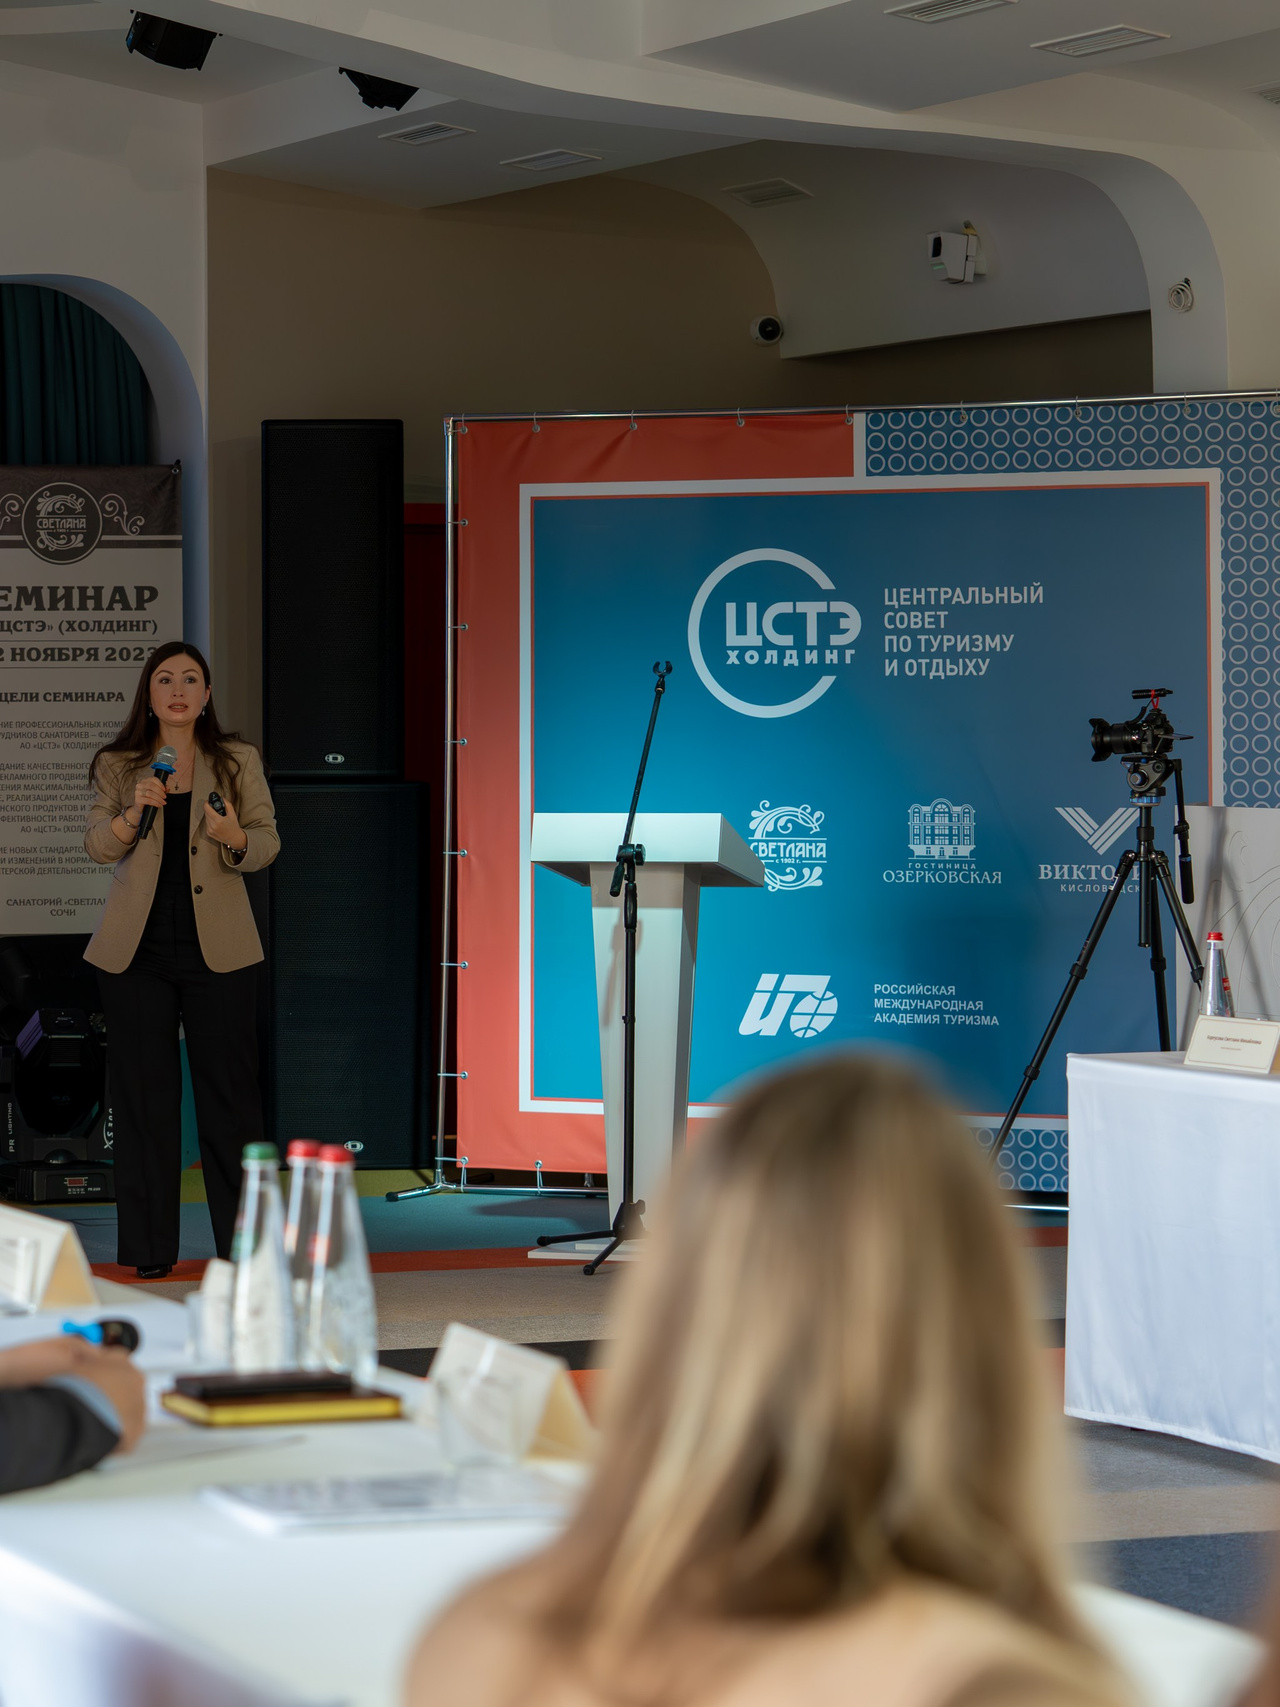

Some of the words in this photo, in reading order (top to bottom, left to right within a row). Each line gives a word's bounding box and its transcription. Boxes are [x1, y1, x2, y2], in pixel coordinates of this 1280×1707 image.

[36, 518, 87, 529] СВЕТЛАНА
[884, 582, 1044, 607] ЦЕНТРАЛЬНЫЙ
[725, 601, 862, 647] ЦСТЭ
[884, 611, 948, 629] СОВЕТ
[58, 619, 158, 635] (ХОЛДИНГ)
[884, 635, 912, 653] ПО
[918, 634, 1014, 653] ТУРИЗМУ
[10, 647, 100, 662] НОЯБРЯ
[726, 649, 856, 667] ХОЛДИНГ
[885, 659, 898, 677] И
[904, 658, 990, 680] ОТДЫХУ
[43, 692, 125, 703] СЕМИНАРА
[15, 721, 101, 729] ПРОФЕССИОНАЛЬНЫХ
[39, 731, 90, 739] САНАТОРИЕВ
[20, 742, 31, 750] АО
[6, 794, 58, 802] РЕАЛИЗАЦИИ
[33, 804, 79, 813] ПРОДУКТОВ
[80, 804, 86, 812] И
[9, 846, 38, 854] НОВЫХ
[750, 842, 827, 858] СВЕТЛАНА
[8, 855, 56, 864] ИЗМЕНЕНИЙ
[58, 856, 63, 864] В
[37, 866, 97, 876] ДЕЯТЕЛЬНОСТИ
[908, 862, 976, 870] ГОСТИНИЦА
[882, 869, 1002, 884] ОЗЕРКОВСКАЯ
[1060, 884, 1140, 893] КИСЛОВДСК
[6, 897, 62, 906] САНАТОРИЙ
[50, 908, 76, 917] СОЧИ
[874, 982, 956, 996] РОССИЙСКАЯ
[874, 998, 984, 1012] МЕЖДУНАРОДНАЯ
[873, 1012, 940, 1025] АКАДЕМИЯ
[943, 1014, 1000, 1026] ТУРИЗМА
[8, 1139, 15, 1153] PR
